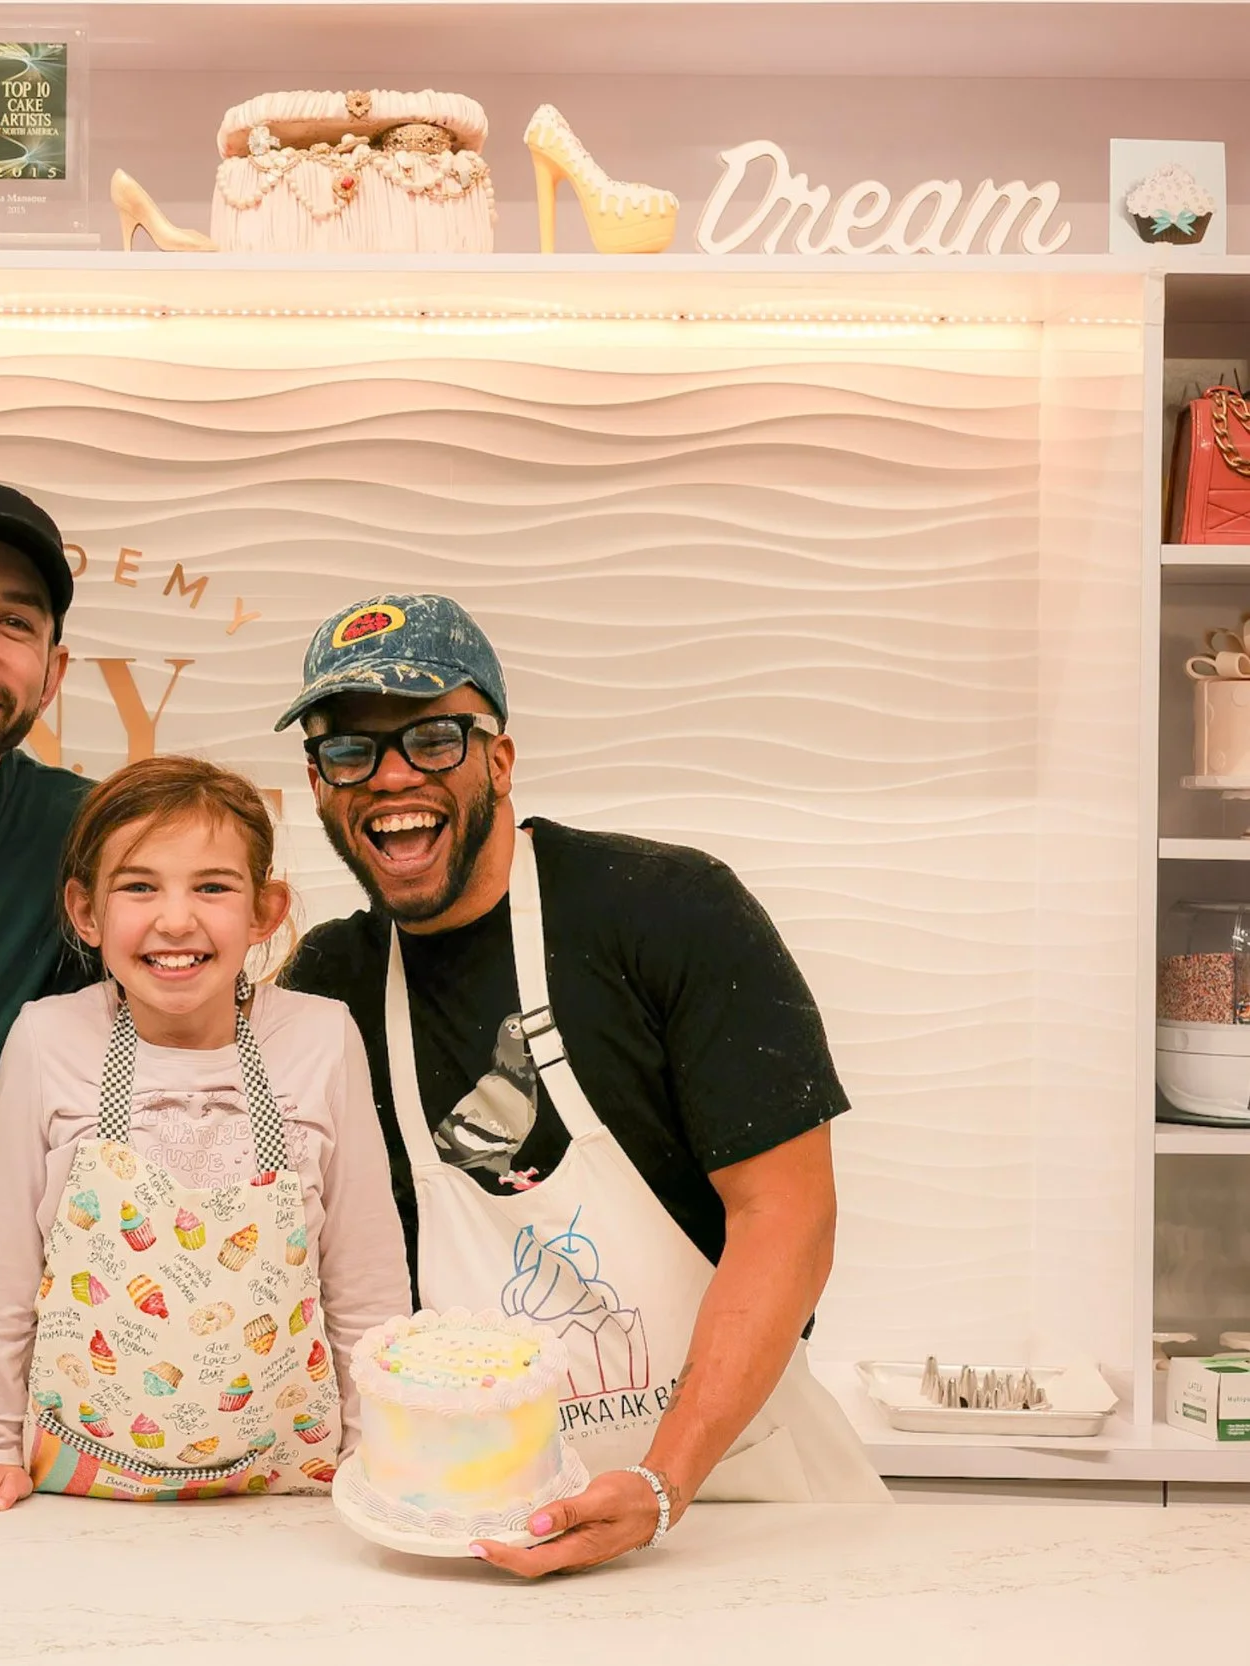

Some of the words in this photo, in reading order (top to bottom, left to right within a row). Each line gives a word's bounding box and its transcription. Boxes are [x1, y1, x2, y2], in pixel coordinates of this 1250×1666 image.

[1, 81, 31, 98] TOP
[36, 81, 51, 98] 10
[7, 98, 44, 112] CAKE
[0, 112, 52, 127] ARTISTS
[2, 127, 26, 135] NORTH
[27, 127, 59, 136] AMERICA
[695, 139, 1072, 256] Dream
[159, 1120, 251, 1149] NATURE
[145, 1144, 225, 1172] GUIDE
